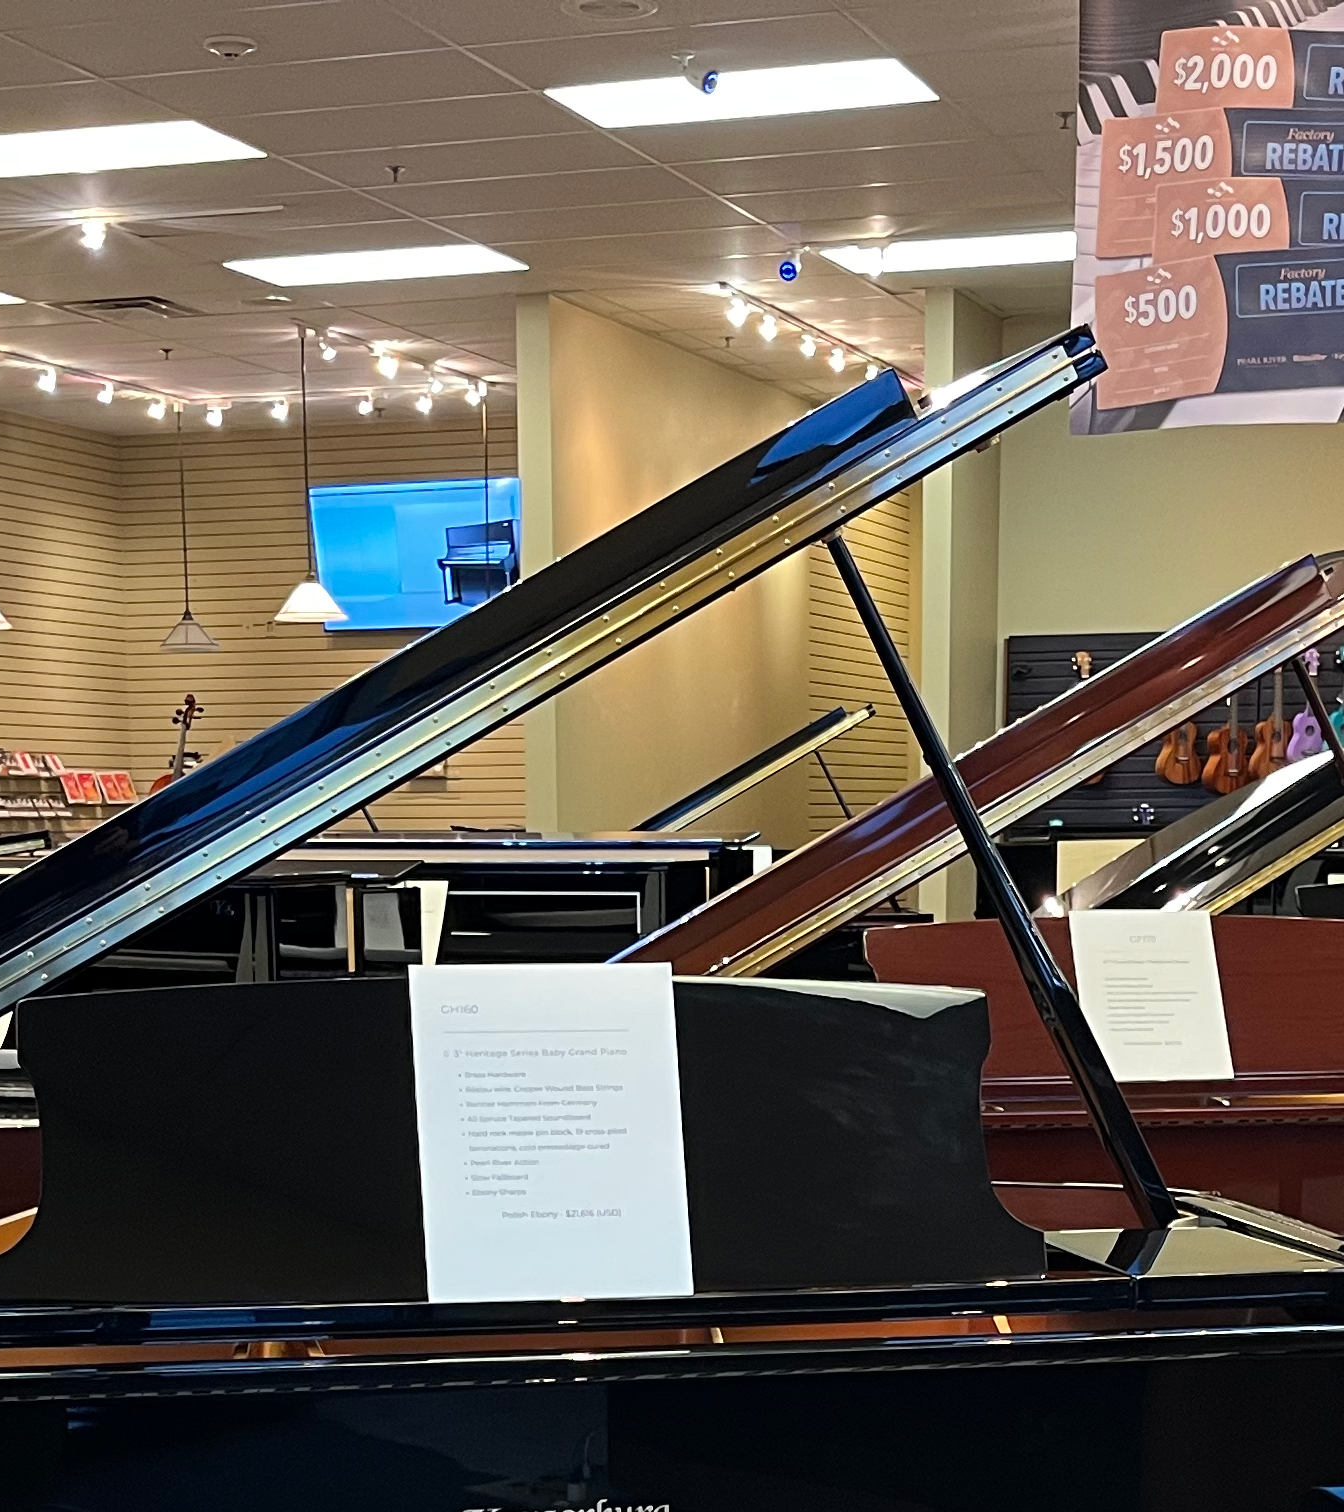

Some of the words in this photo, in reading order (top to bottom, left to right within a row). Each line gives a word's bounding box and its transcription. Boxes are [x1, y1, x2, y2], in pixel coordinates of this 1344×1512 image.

[1173, 52, 1278, 94] $2,000
[1287, 127, 1335, 143] Factory
[1118, 134, 1214, 180] $1,500
[1170, 203, 1271, 244] $1,000
[1280, 267, 1326, 280] Factory
[1124, 284, 1197, 326] $500
[510, 1049, 539, 1057] Series
[542, 1049, 565, 1058] Baby
[568, 1048, 597, 1056] Grand
[600, 1048, 627, 1056] Piano
